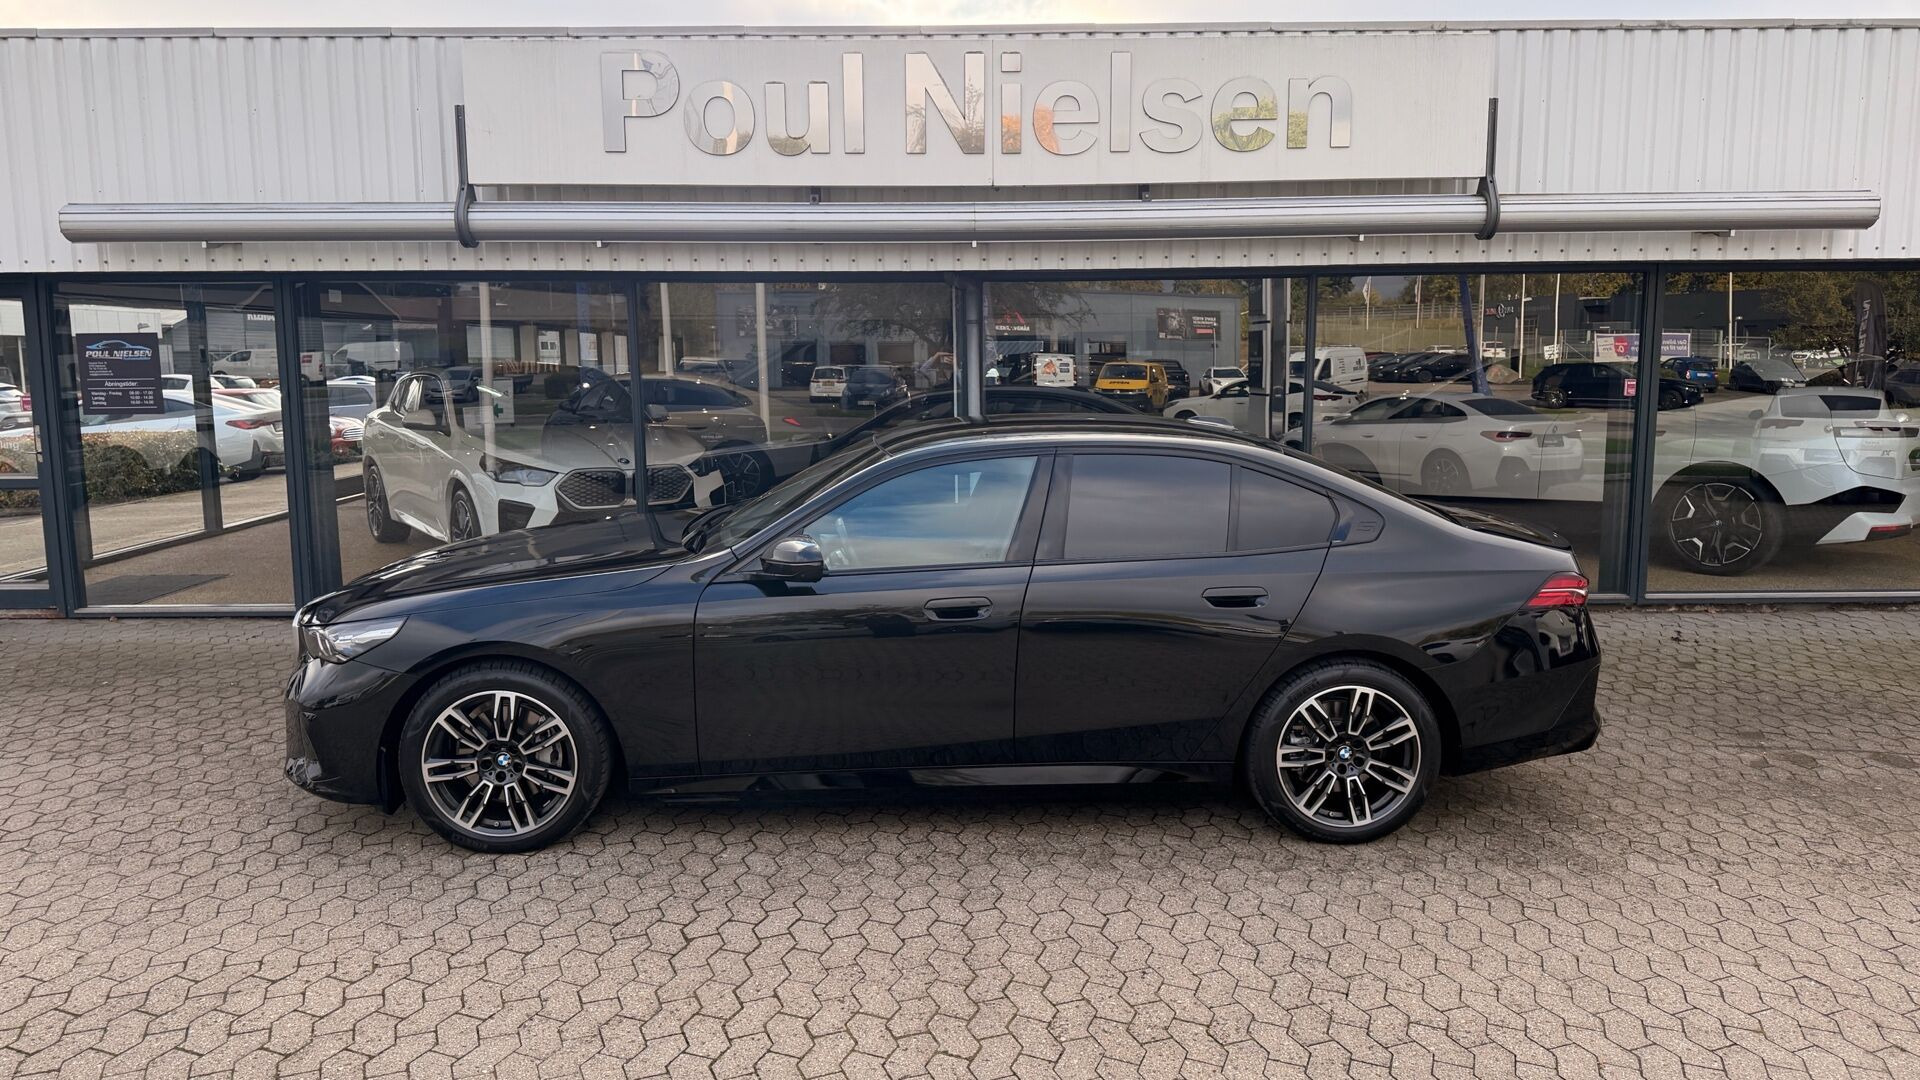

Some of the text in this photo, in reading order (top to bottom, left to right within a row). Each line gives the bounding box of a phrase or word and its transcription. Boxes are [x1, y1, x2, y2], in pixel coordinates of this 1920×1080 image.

[601, 50, 1351, 156] Poul Nielsen
[85, 350, 110, 358] POUL
